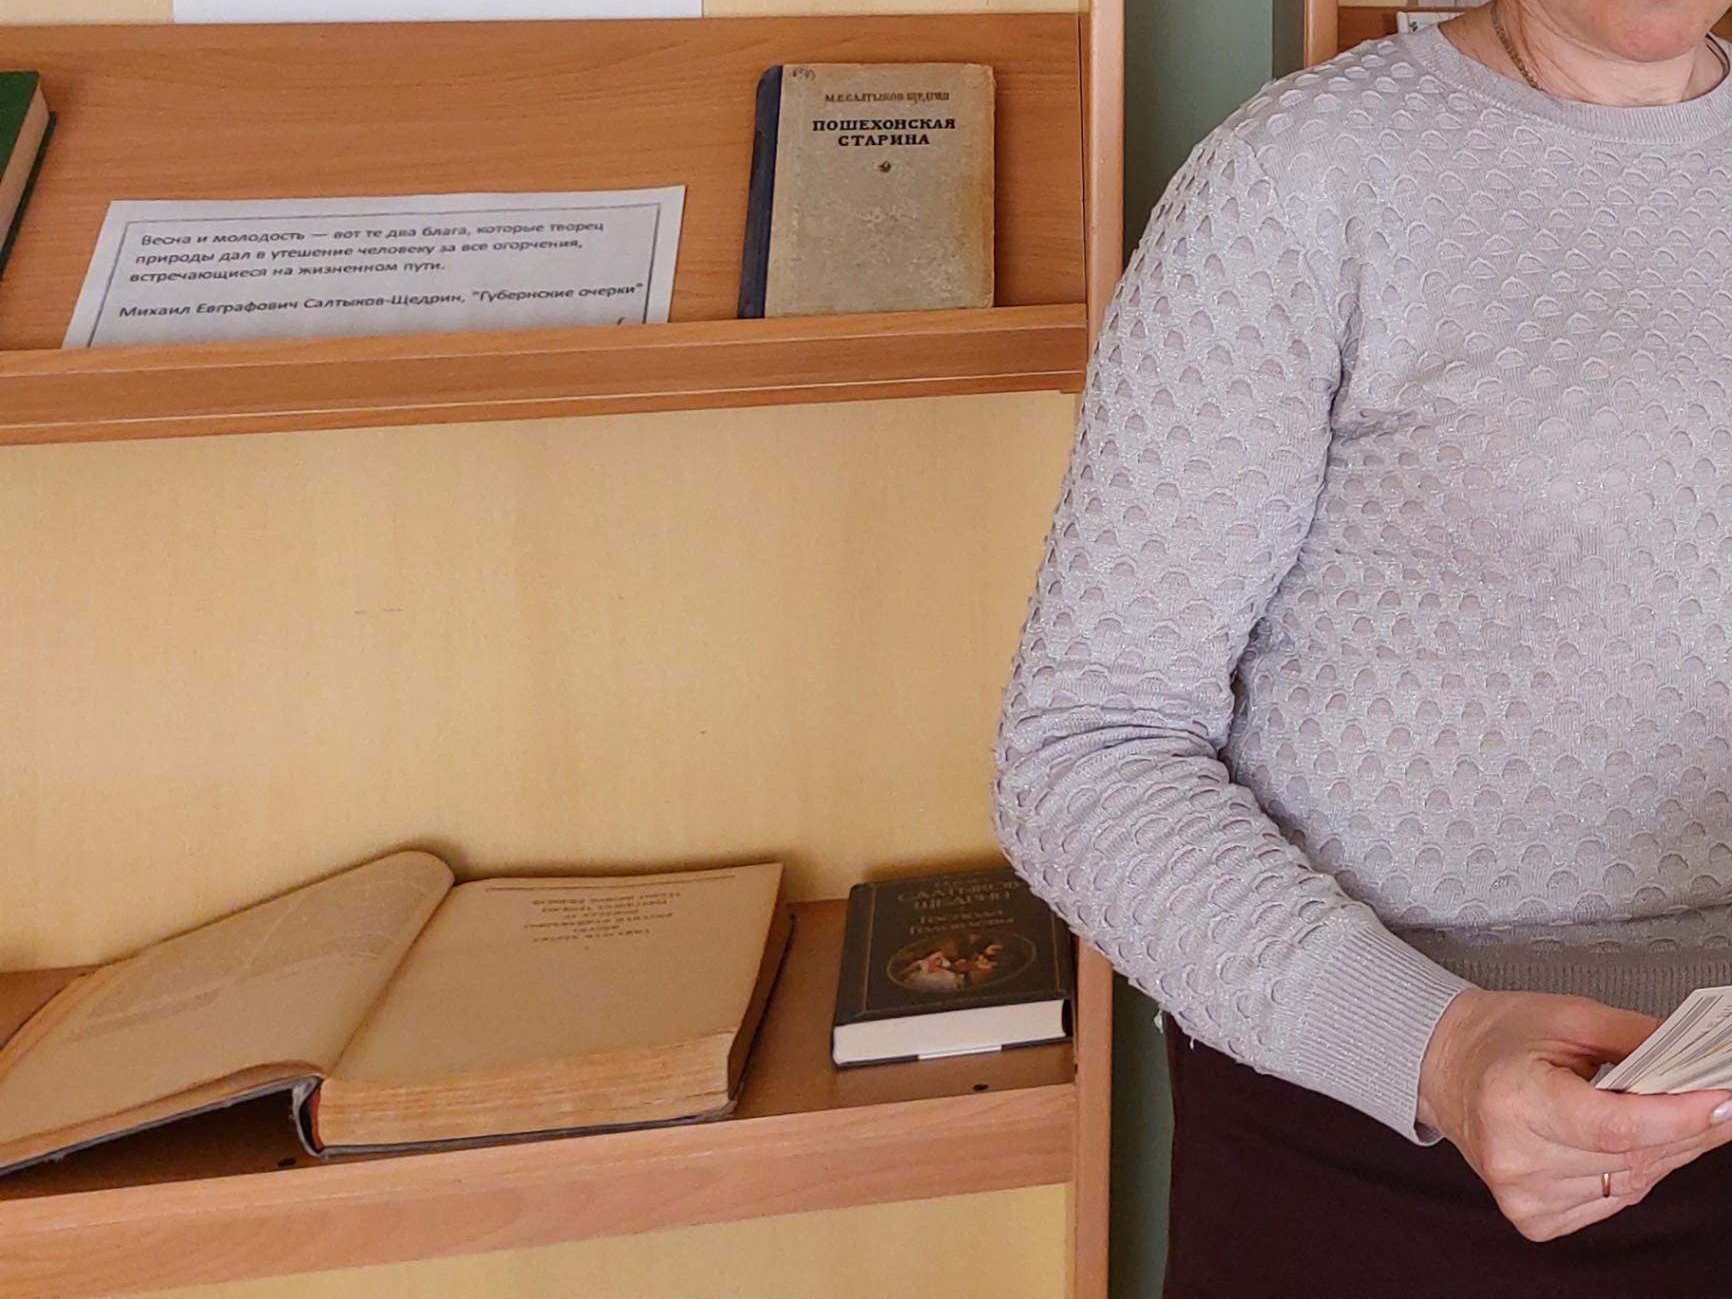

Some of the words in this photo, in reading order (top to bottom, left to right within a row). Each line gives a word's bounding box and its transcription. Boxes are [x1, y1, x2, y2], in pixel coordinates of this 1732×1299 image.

[812, 118, 956, 132] ПОШЕХОНСКАЯ
[838, 133, 930, 147] СТАРИНА
[141, 235, 191, 245] Весна
[197, 236, 208, 244] и
[212, 231, 304, 243] молодость
[333, 230, 361, 239] вот
[366, 230, 382, 238] те
[386, 228, 417, 239] два
[422, 225, 471, 237] блага,
[477, 223, 545, 235] которые
[550, 221, 604, 233] творец
[135, 252, 215, 266] природы
[218, 251, 251, 263] дал
[256, 251, 265, 259] в
[270, 247, 353, 261] утешение
[358, 245, 436, 258] человеку
[440, 244, 456, 252] за
[461, 242, 488, 251] все
[493, 239, 583, 253] огорчения,
[129, 268, 267, 283] встречающиеся
[272, 268, 293, 276] на
[298, 261, 397, 276] жизненном
[403, 260, 445, 273] пути.
[119, 305, 190, 318] Михаил
[196, 298, 298, 315] Евграфович
[303, 293, 465, 309] Салтыков-Щедрин,
[472, 286, 575, 303] "Губернские
[578, 283, 643, 299] очерки"
